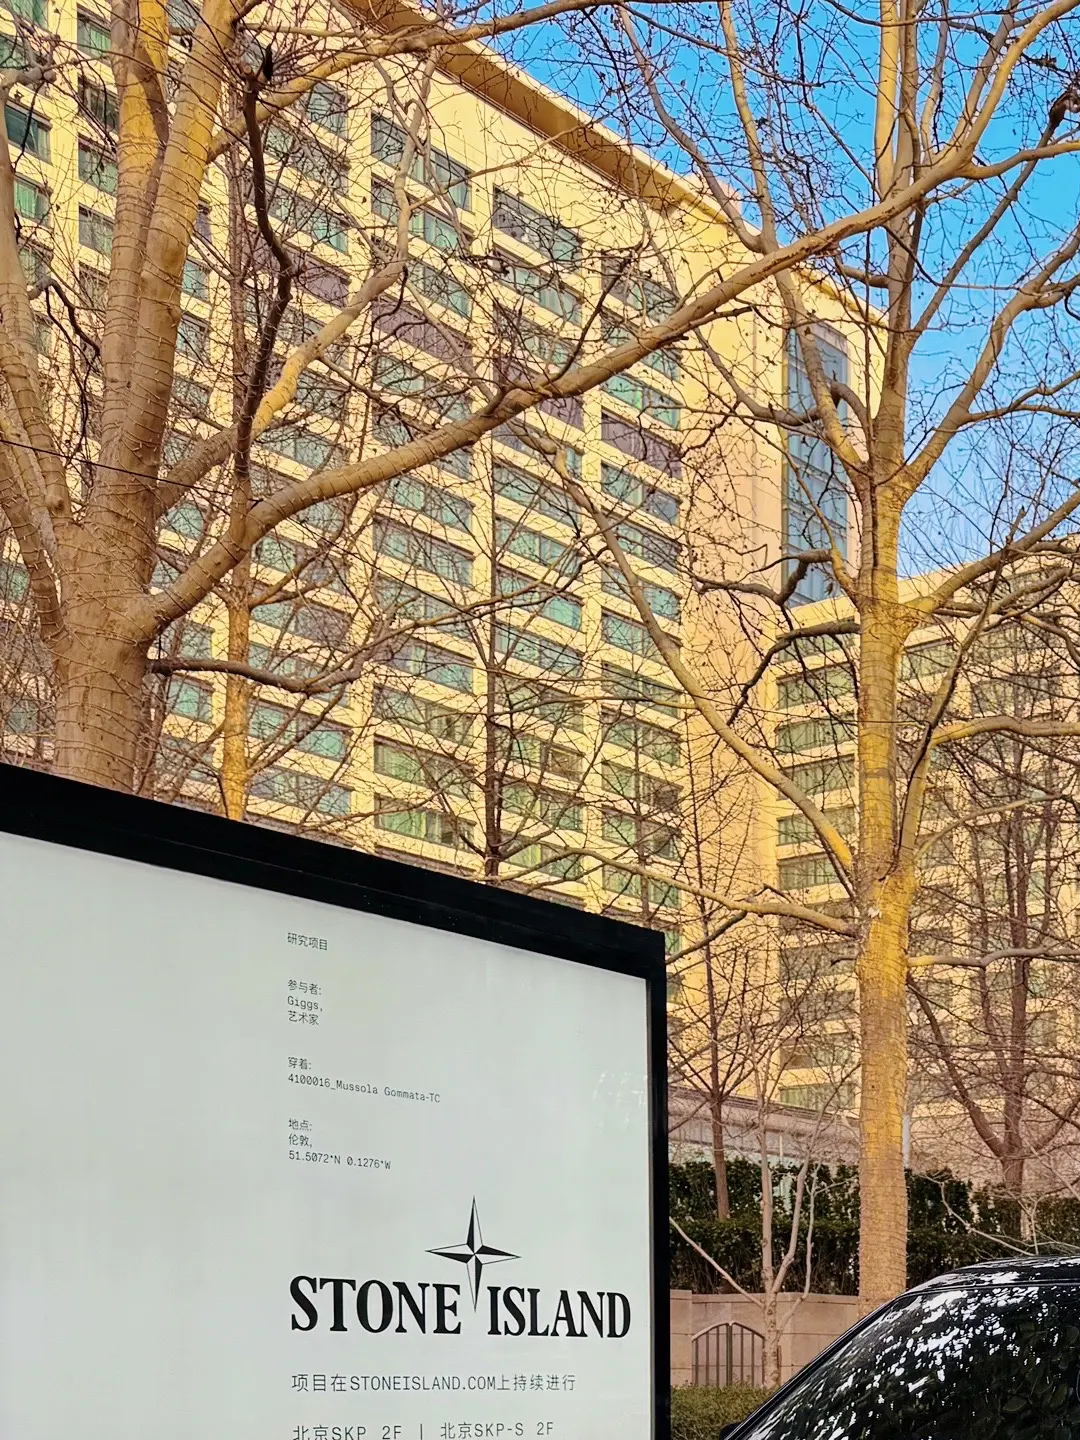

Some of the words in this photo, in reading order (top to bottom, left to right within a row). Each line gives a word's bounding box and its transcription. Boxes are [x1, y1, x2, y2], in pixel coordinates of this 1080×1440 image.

[287, 932, 328, 951] 研究项目
[287, 996, 323, 1012] Giggs,
[288, 1010, 319, 1026] 艺术家
[384, 1087, 441, 1103] Gommata-TC
[289, 1275, 462, 1335] STONE
[486, 1285, 632, 1338] ISLAND
[291, 1373, 576, 1393] 项目在STONEISLAND.COM上持续进行
[382, 1425, 403, 1440] 2F
[440, 1421, 524, 1440] 北京SKP-S
[536, 1421, 554, 1436] 2F
